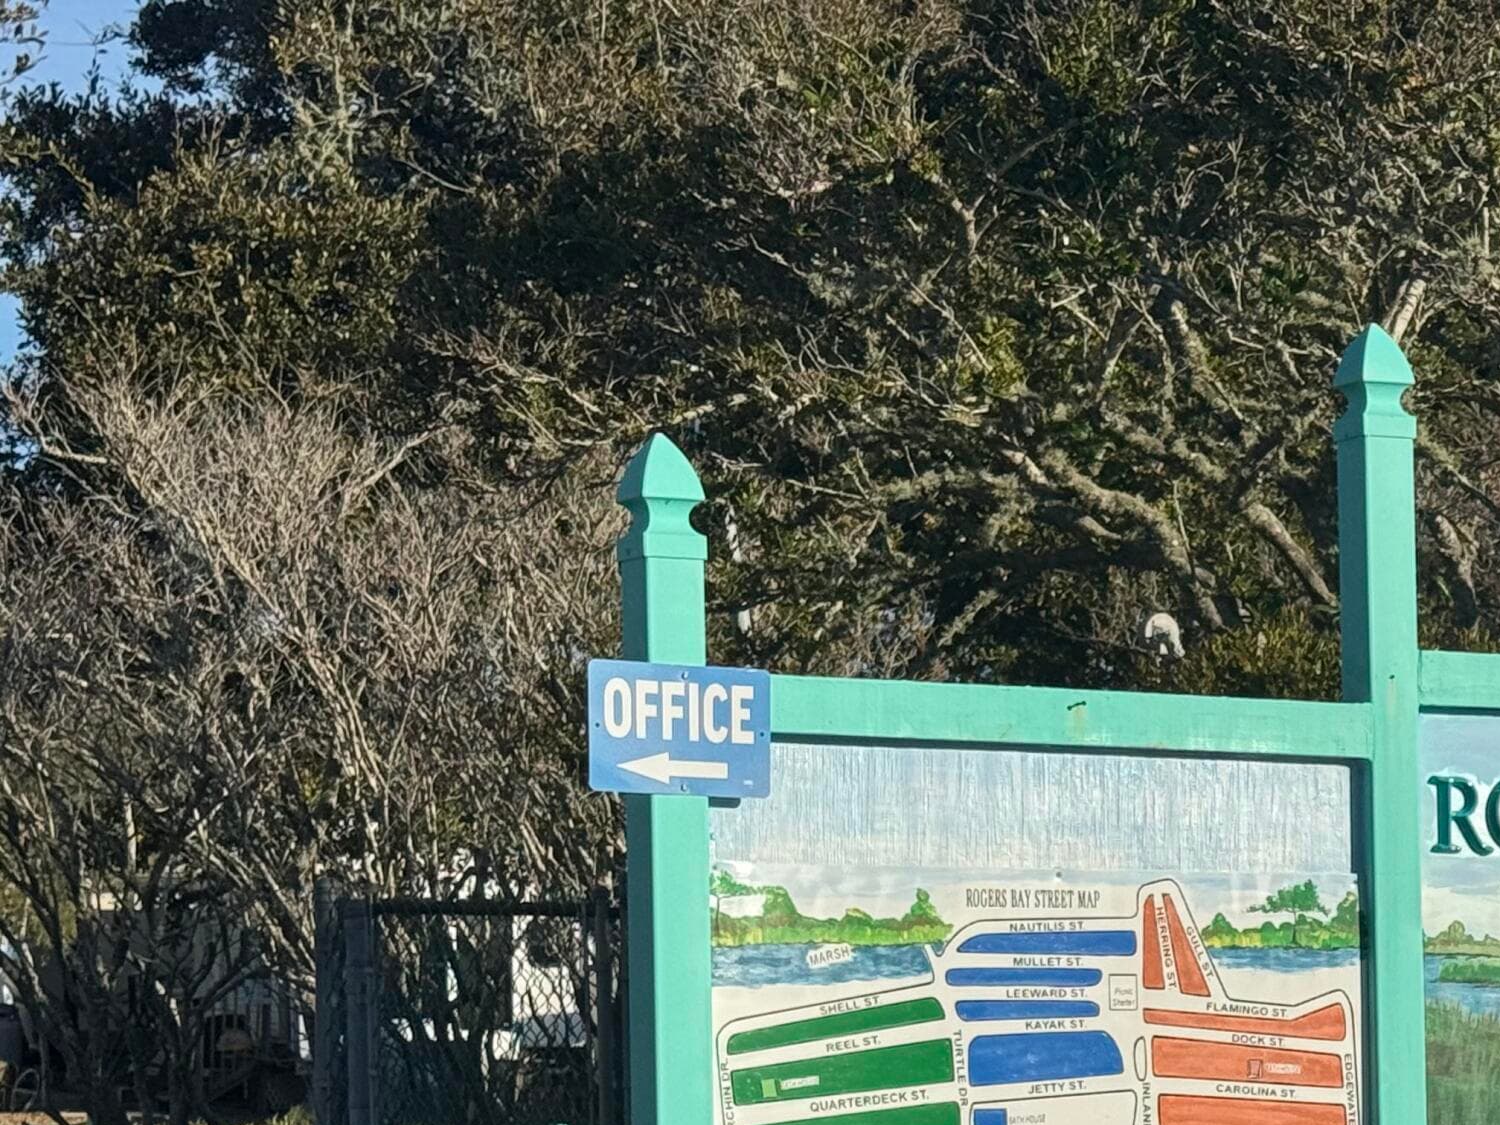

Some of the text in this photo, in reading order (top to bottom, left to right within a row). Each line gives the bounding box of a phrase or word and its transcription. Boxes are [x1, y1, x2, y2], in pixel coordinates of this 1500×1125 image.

[604, 677, 755, 745] OFFICE
[966, 888, 1101, 909] ROGERS BAY STREET MAP
[1009, 922, 1066, 932] NAUTILIS
[1155, 906, 1173, 968] HERRING
[1186, 926, 1205, 961] GULL
[809, 945, 850, 966] MARSH
[1012, 957, 1061, 967] MULLET
[1006, 988, 1067, 999] LEEWARD
[819, 998, 860, 1016] SHELL
[1206, 1002, 1269, 1016] FLAMINGO
[1025, 1020, 1066, 1030] KAYAK
[825, 1039, 861, 1053] REEL
[1231, 1034, 1265, 1045] DOCK
[953, 1029, 967, 1084] TURTLE
[1028, 1083, 1065, 1095] JETTY
[1216, 1084, 1277, 1097] CAROLINA
[810, 1093, 907, 1112] QUARTERDECK
